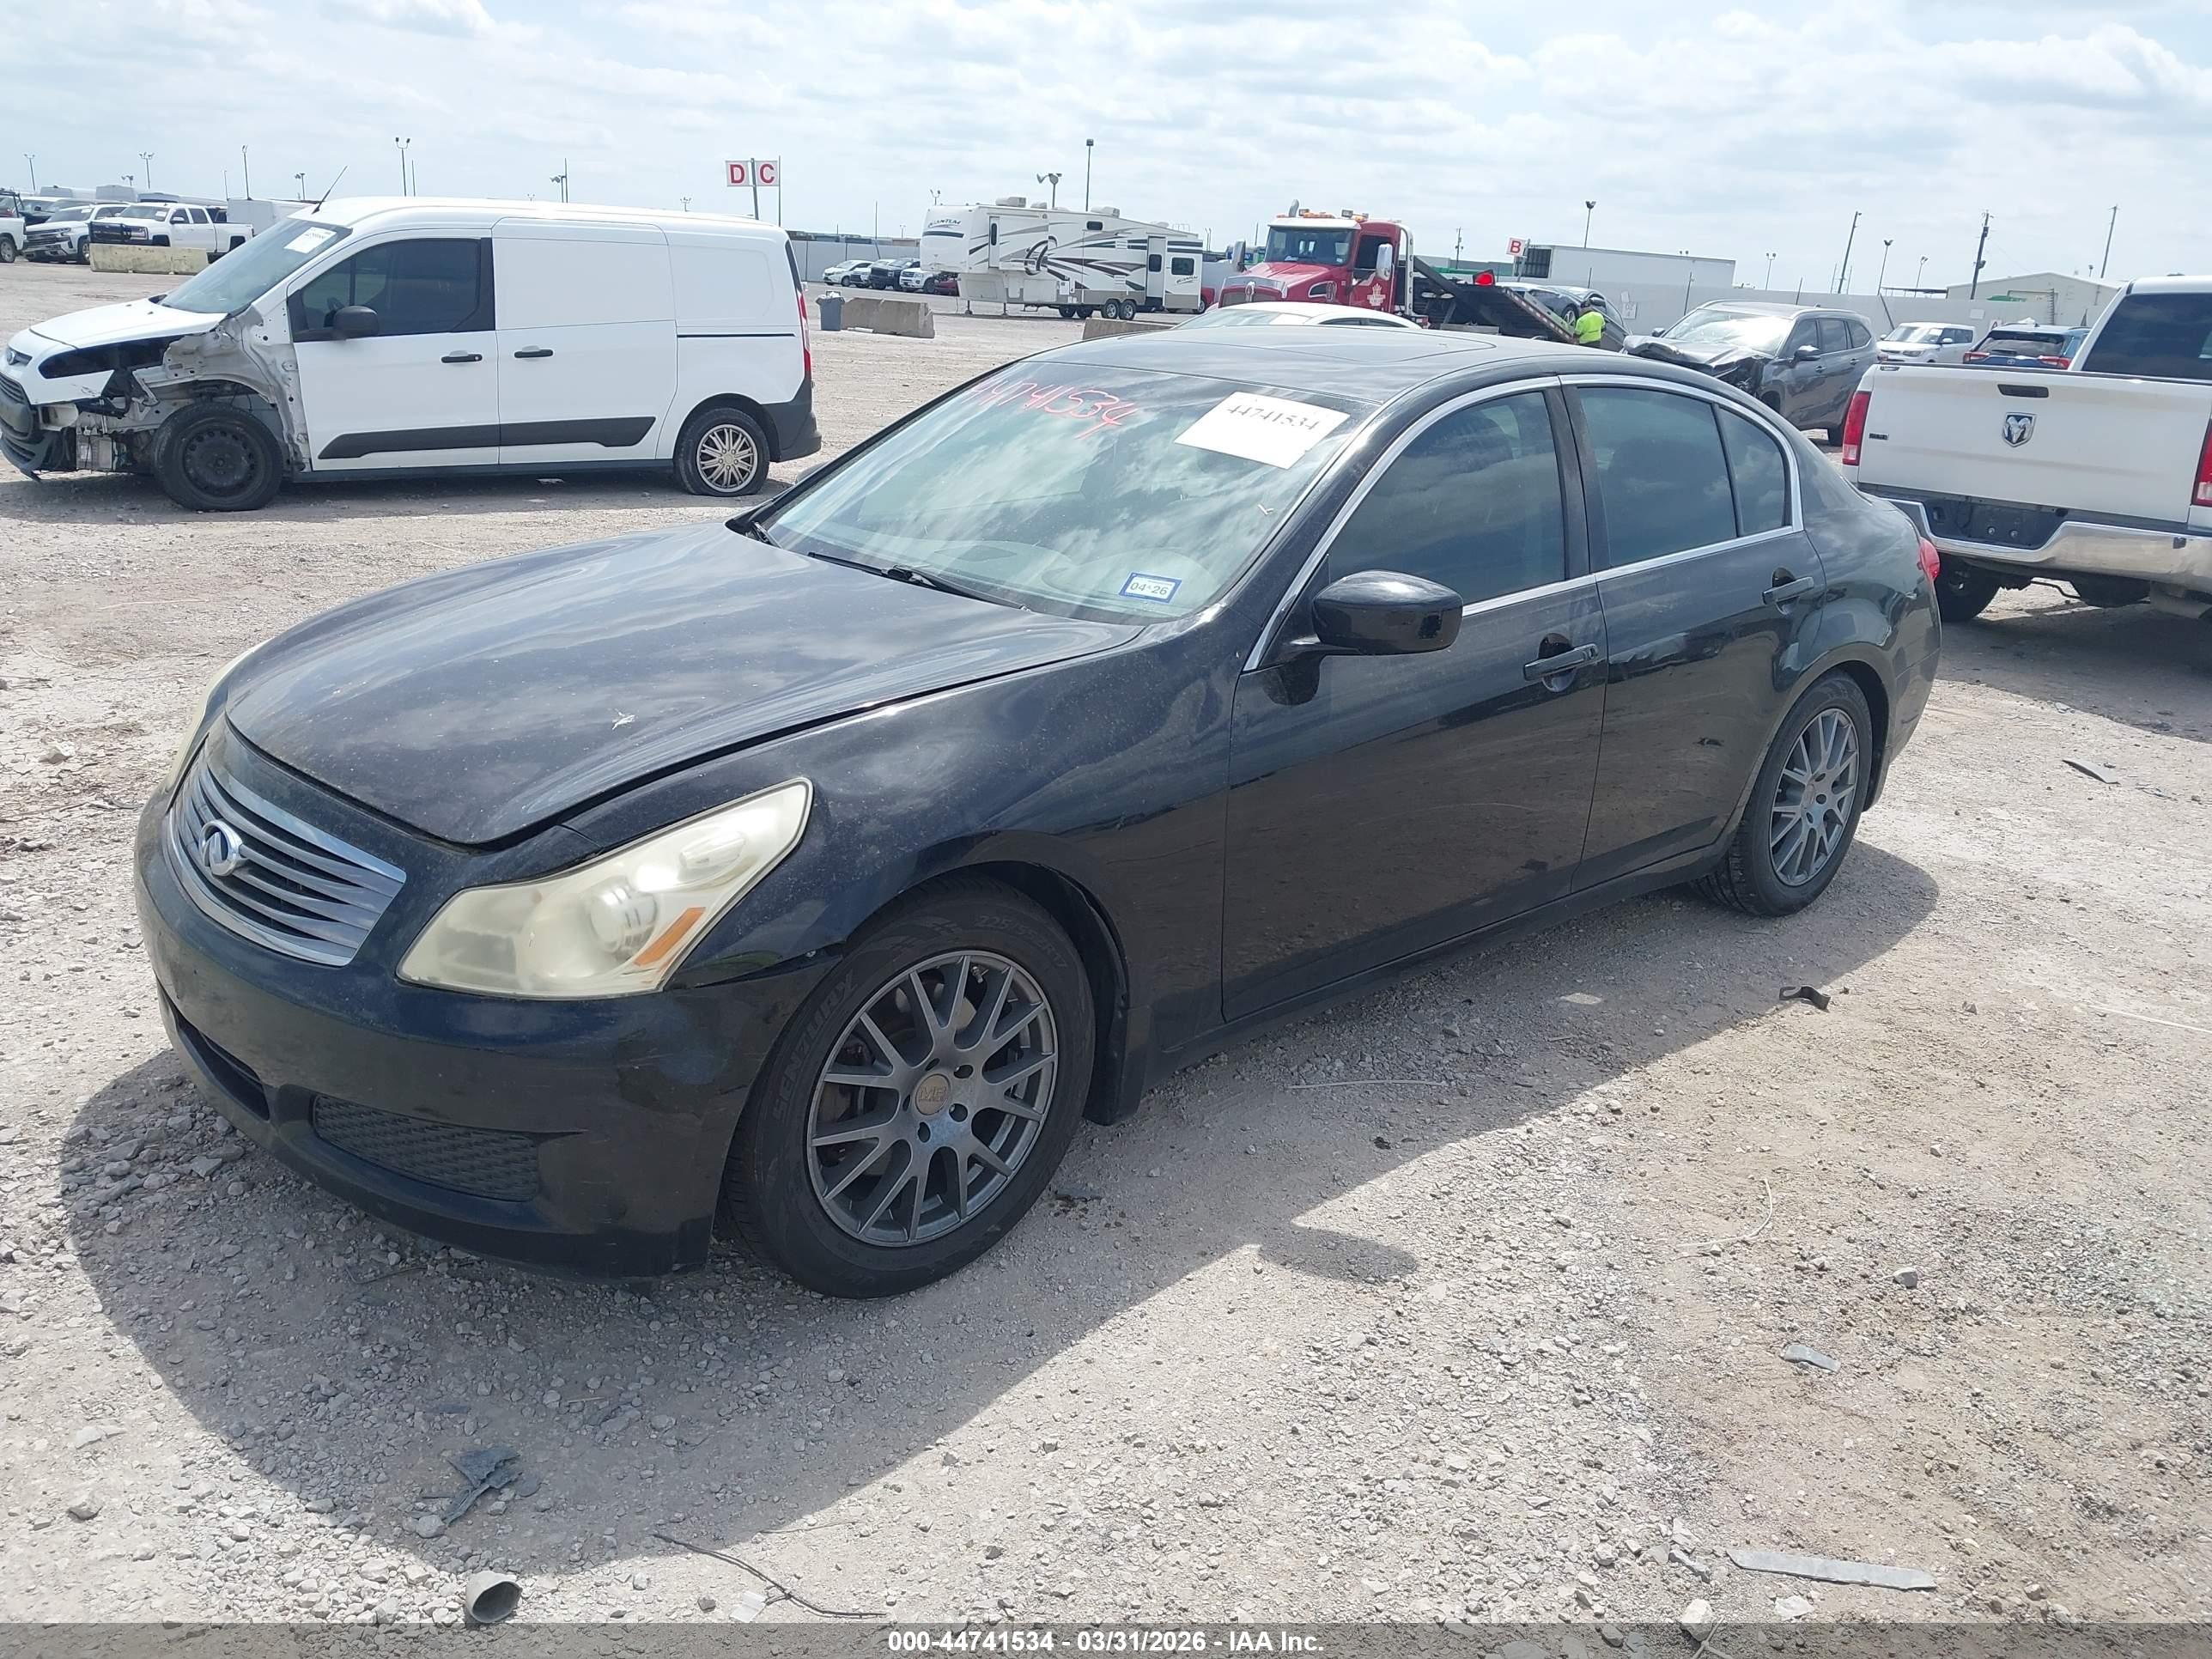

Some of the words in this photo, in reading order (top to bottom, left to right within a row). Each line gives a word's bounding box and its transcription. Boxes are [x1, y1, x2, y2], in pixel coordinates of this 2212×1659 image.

[730, 164, 744, 184] D
[760, 164, 775, 184] C
[1510, 240, 1521, 253] B
[962, 378, 1139, 441] 44741534
[1227, 404, 1320, 430] 44741534
